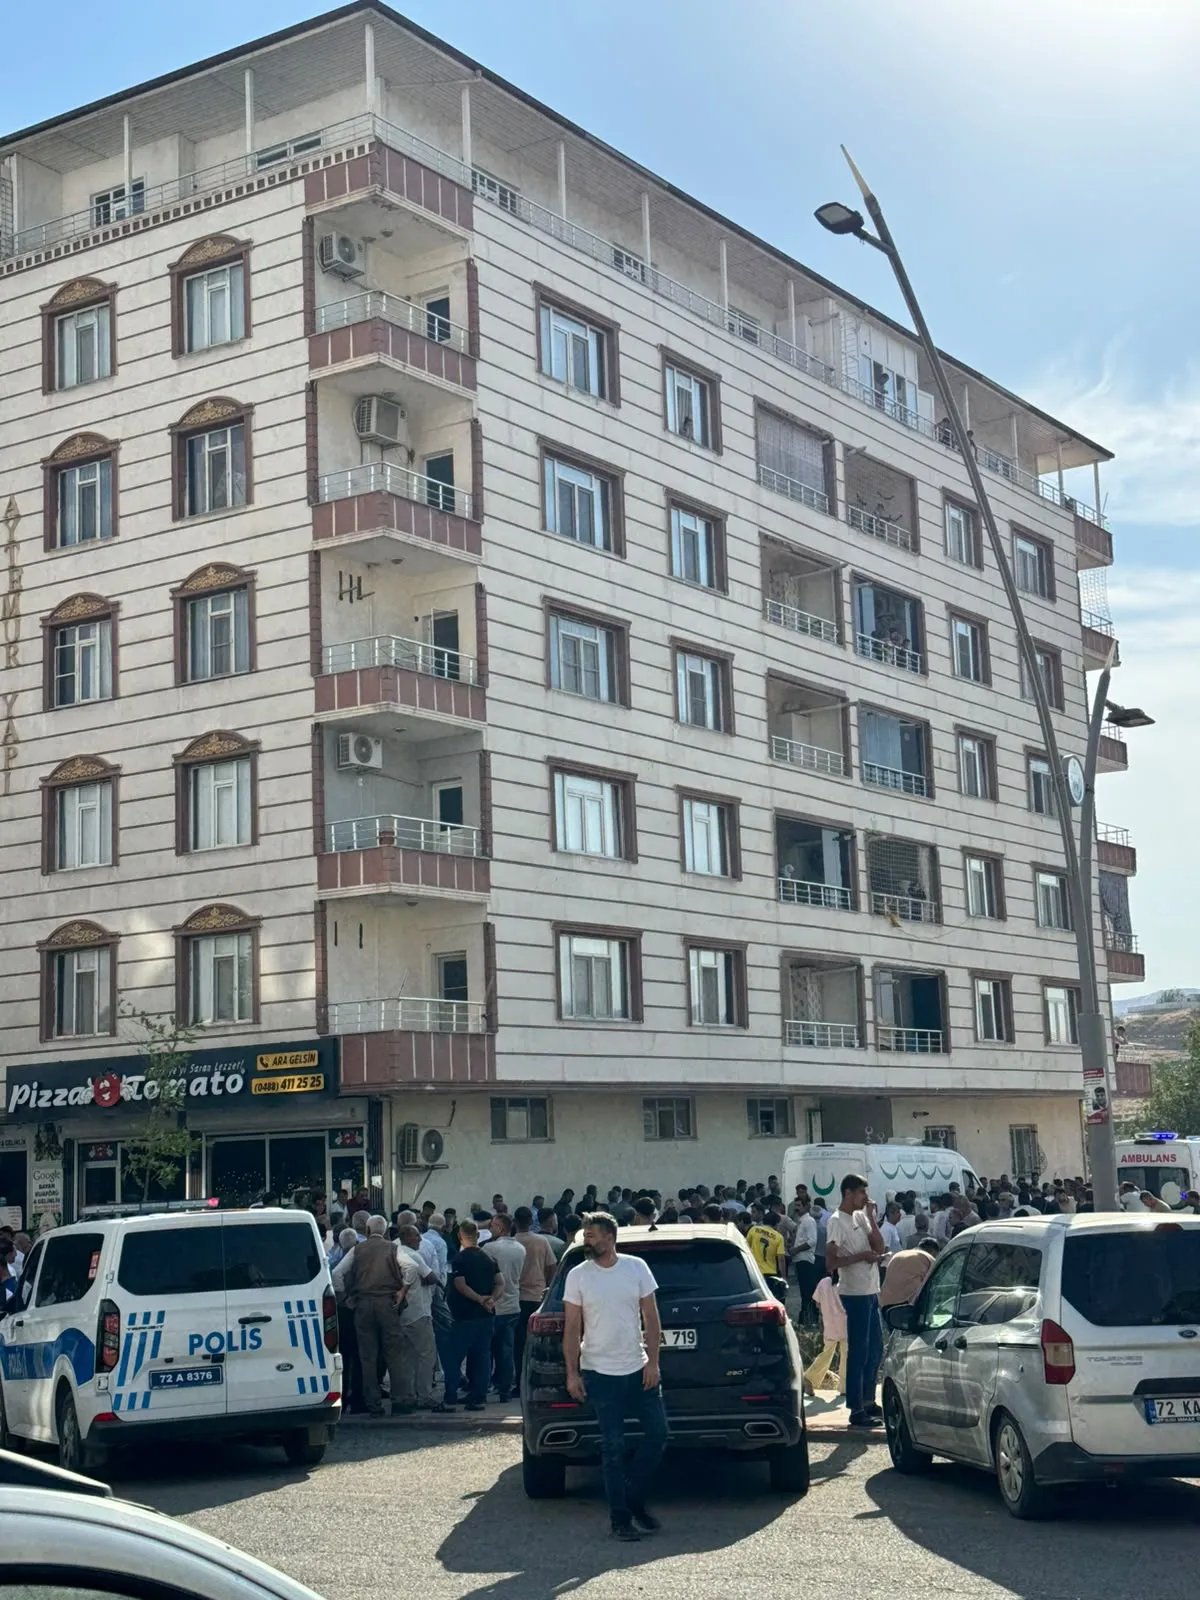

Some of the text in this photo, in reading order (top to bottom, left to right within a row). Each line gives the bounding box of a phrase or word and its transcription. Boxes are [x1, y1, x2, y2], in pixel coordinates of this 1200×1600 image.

[2, 694, 20, 796] YAPI
[272, 1052, 316, 1066] ARA GELSİN
[189, 1063, 212, 1075] Saran
[254, 1075, 322, 1093] (0488) 411 25 25
[8, 1071, 244, 1113] Pizza Tomato
[1120, 1153, 1177, 1163] AMBULANS
[33, 1169, 61, 1183] Google
[760, 1237, 770, 1262] 7
[188, 1323, 263, 1356] POLİS
[672, 1330, 696, 1345] 719
[159, 1371, 213, 1384] 72 A 8376
[1156, 1401, 1175, 1417] 72
